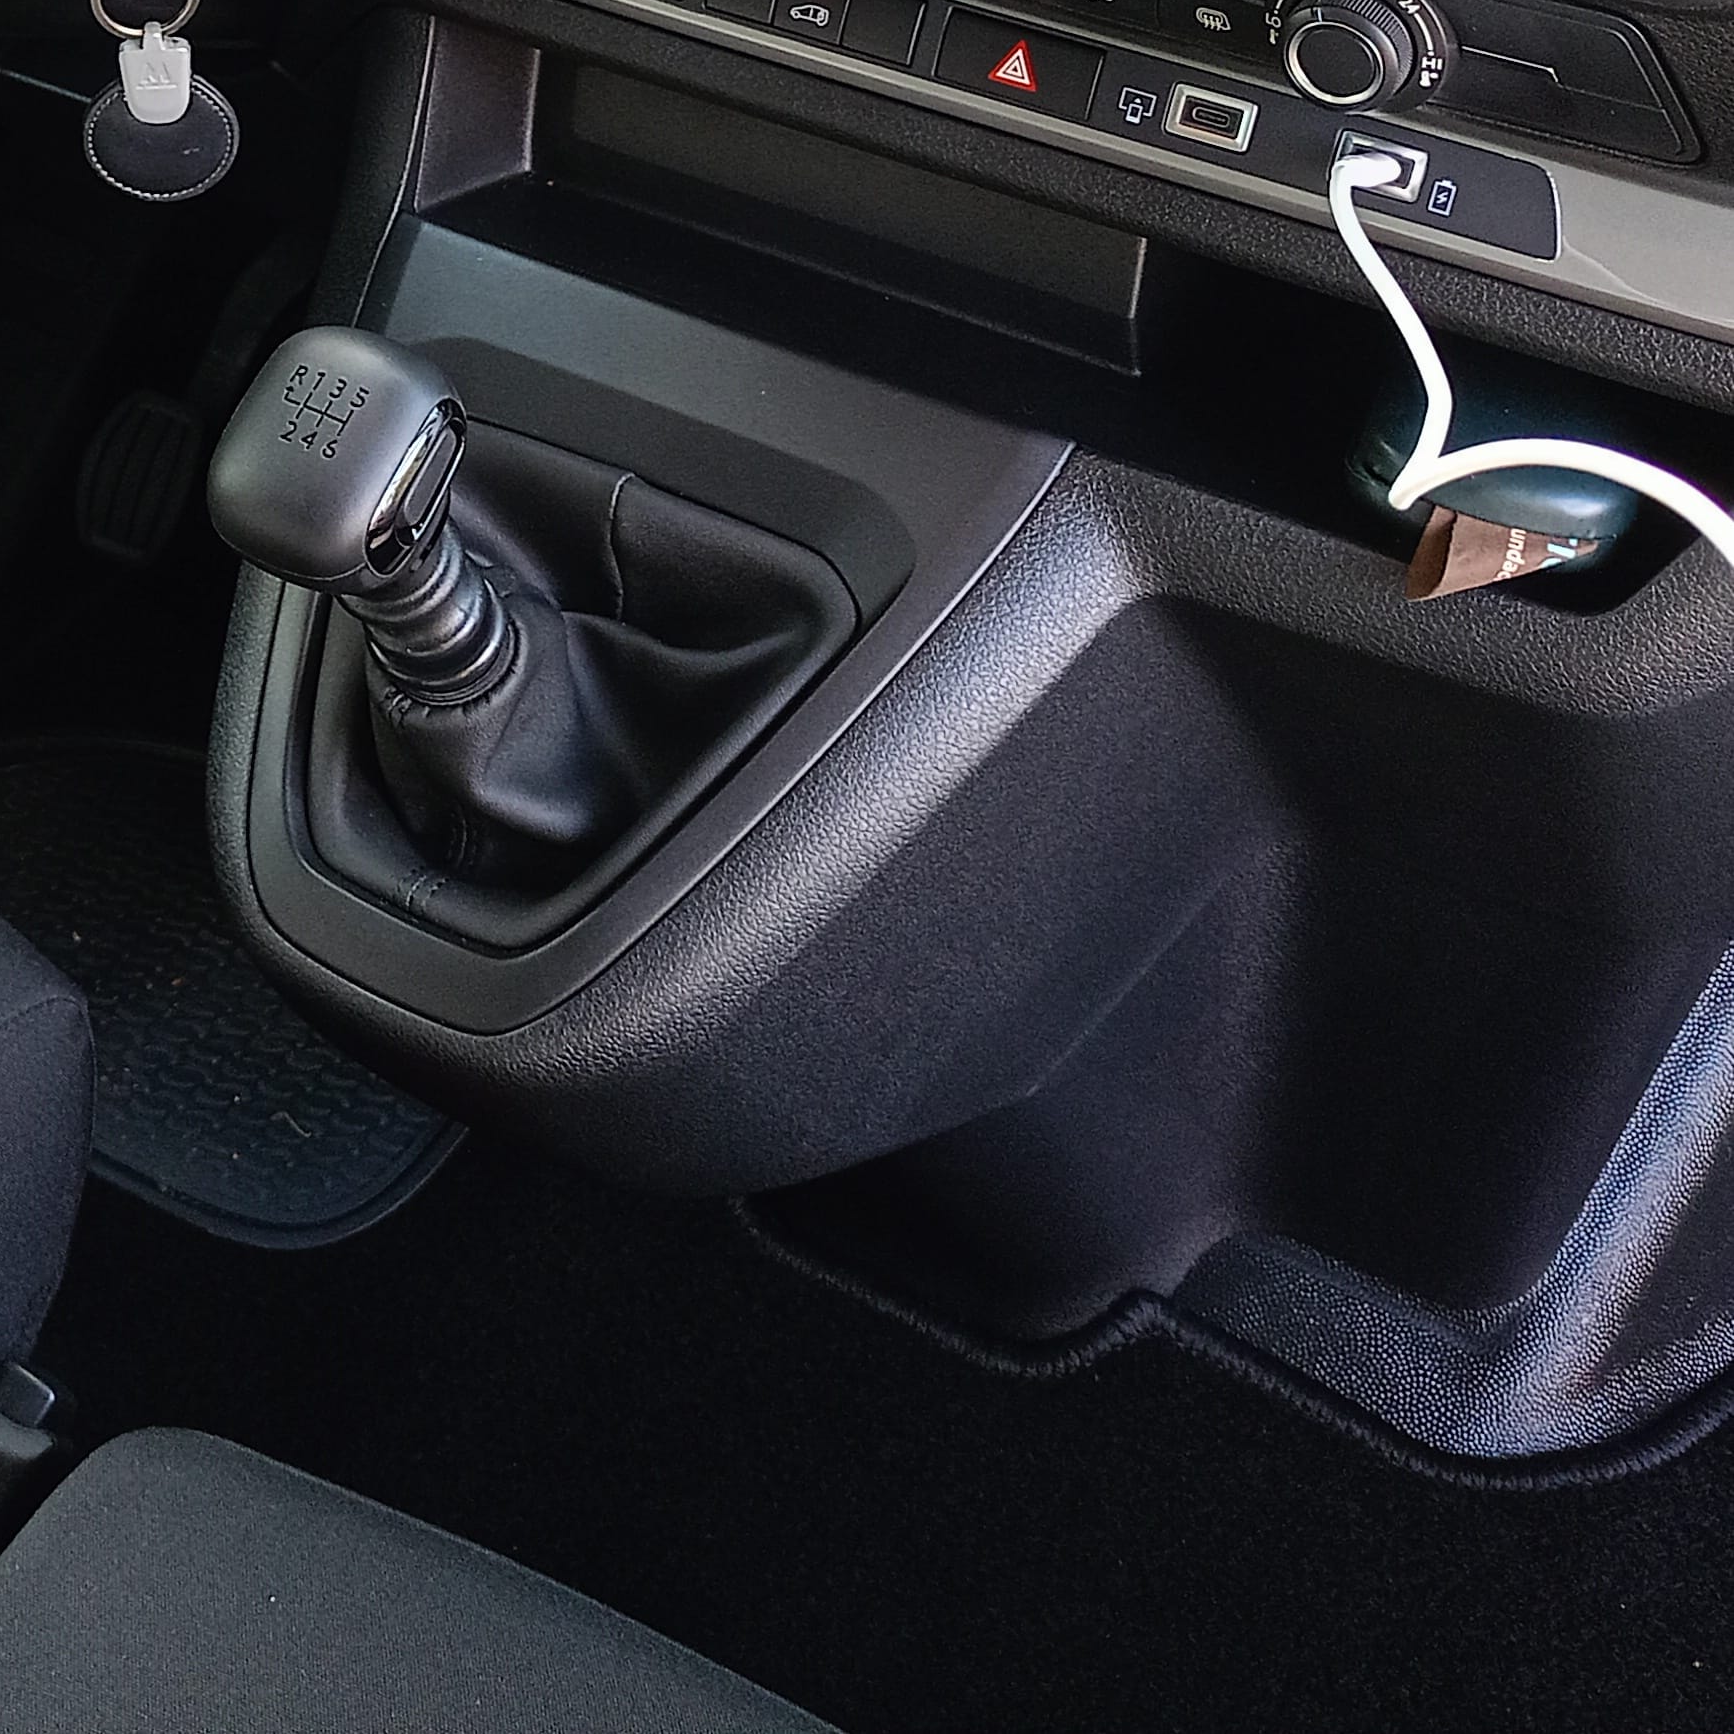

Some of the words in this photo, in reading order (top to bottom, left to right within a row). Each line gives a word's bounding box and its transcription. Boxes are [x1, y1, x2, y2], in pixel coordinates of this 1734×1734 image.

[1421, 56, 1443, 71] HI
[289, 364, 309, 386] R
[312, 371, 326, 391] 1
[328, 378, 347, 399] 3
[349, 386, 370, 408] 5
[279, 419, 297, 443] 2
[300, 431, 318, 450] 4
[321, 439, 338, 459] 6
